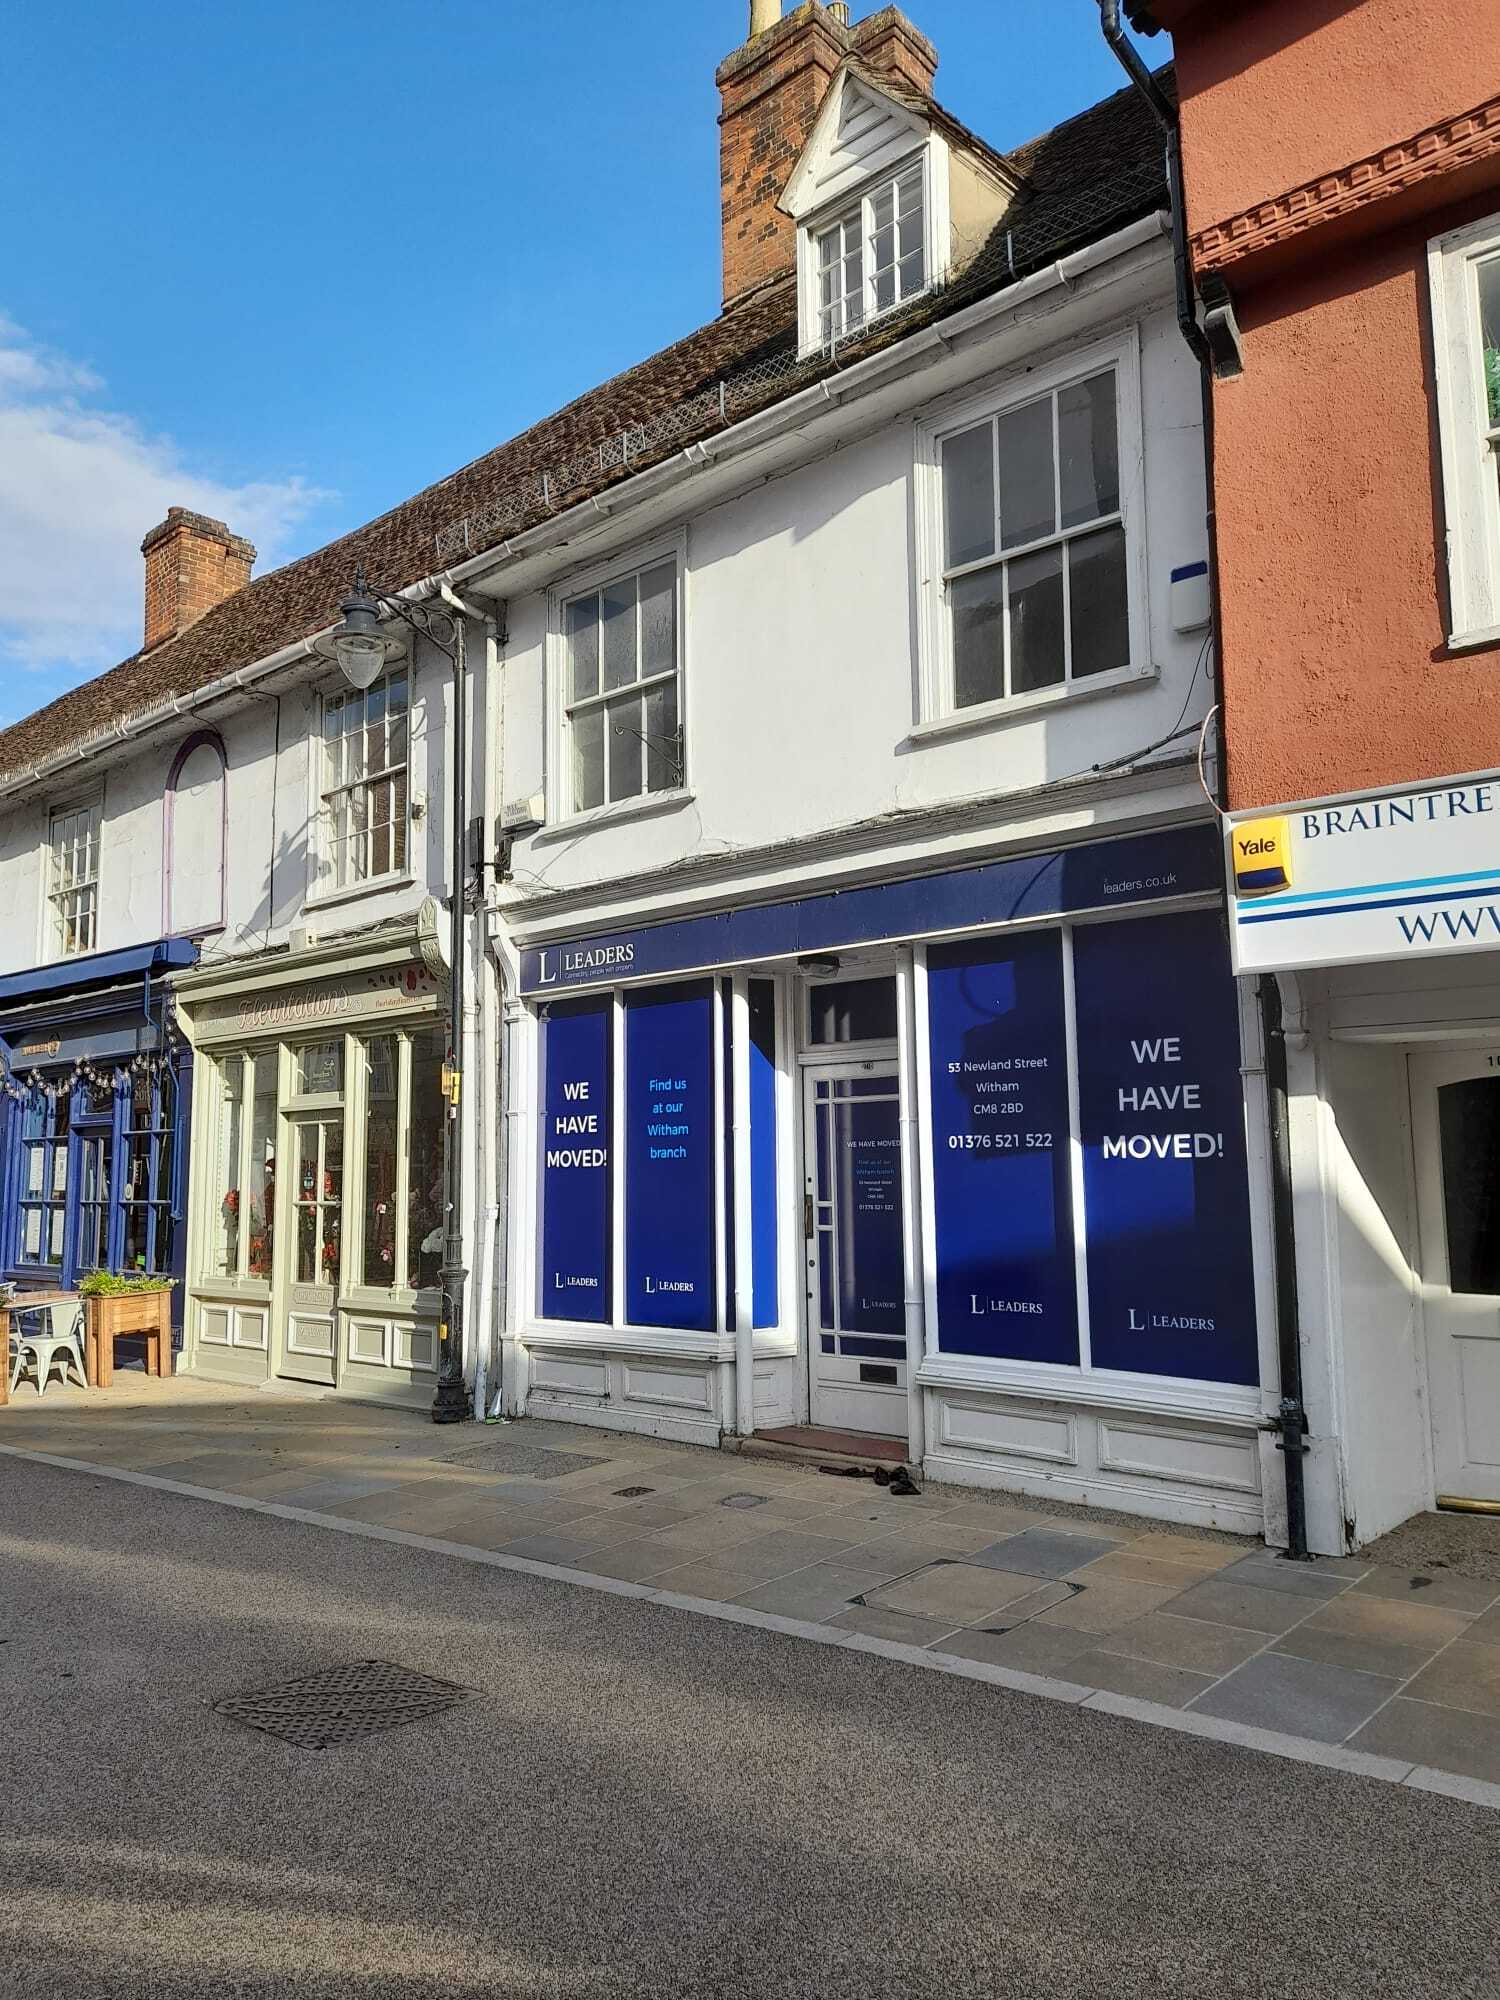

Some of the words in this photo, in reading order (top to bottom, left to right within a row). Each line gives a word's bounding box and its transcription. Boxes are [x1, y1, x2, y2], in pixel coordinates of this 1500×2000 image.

[1302, 784, 1500, 840] BRAINTRE
[1238, 837, 1276, 856] Yale
[1103, 872, 1177, 894] leaders.co.uk
[539, 952, 556, 983] L
[565, 943, 634, 971] LEADERS
[1131, 1038, 1181, 1063] WE
[949, 1063, 960, 1072] 53
[965, 1060, 1010, 1071] Newland
[1015, 1058, 1048, 1068] Street
[564, 1082, 588, 1100] WE
[650, 1079, 671, 1091] Find
[675, 1080, 686, 1089] us
[976, 1082, 1019, 1092] Witham
[1119, 1085, 1200, 1111] HAVE
[653, 1103, 663, 1113] at
[666, 1104, 683, 1112] our
[974, 1104, 997, 1114] CM8
[1001, 1103, 1023, 1113] 2BD
[557, 1115, 597, 1134] HAVE
[648, 1124, 688, 1135] Witham
[949, 1135, 991, 1148] 01376
[996, 1134, 1018, 1147] 521
[1026, 1134, 1052, 1146] 522
[1104, 1134, 1223, 1158] MOVED!
[547, 1149, 607, 1167] MOVED!
[651, 1146, 686, 1158] branch
[568, 1277, 597, 1286] LEADERS
[660, 1282, 693, 1291] LEADERS
[992, 1301, 1042, 1313] LEADERS
[1153, 1316, 1214, 1330] LEADERS
